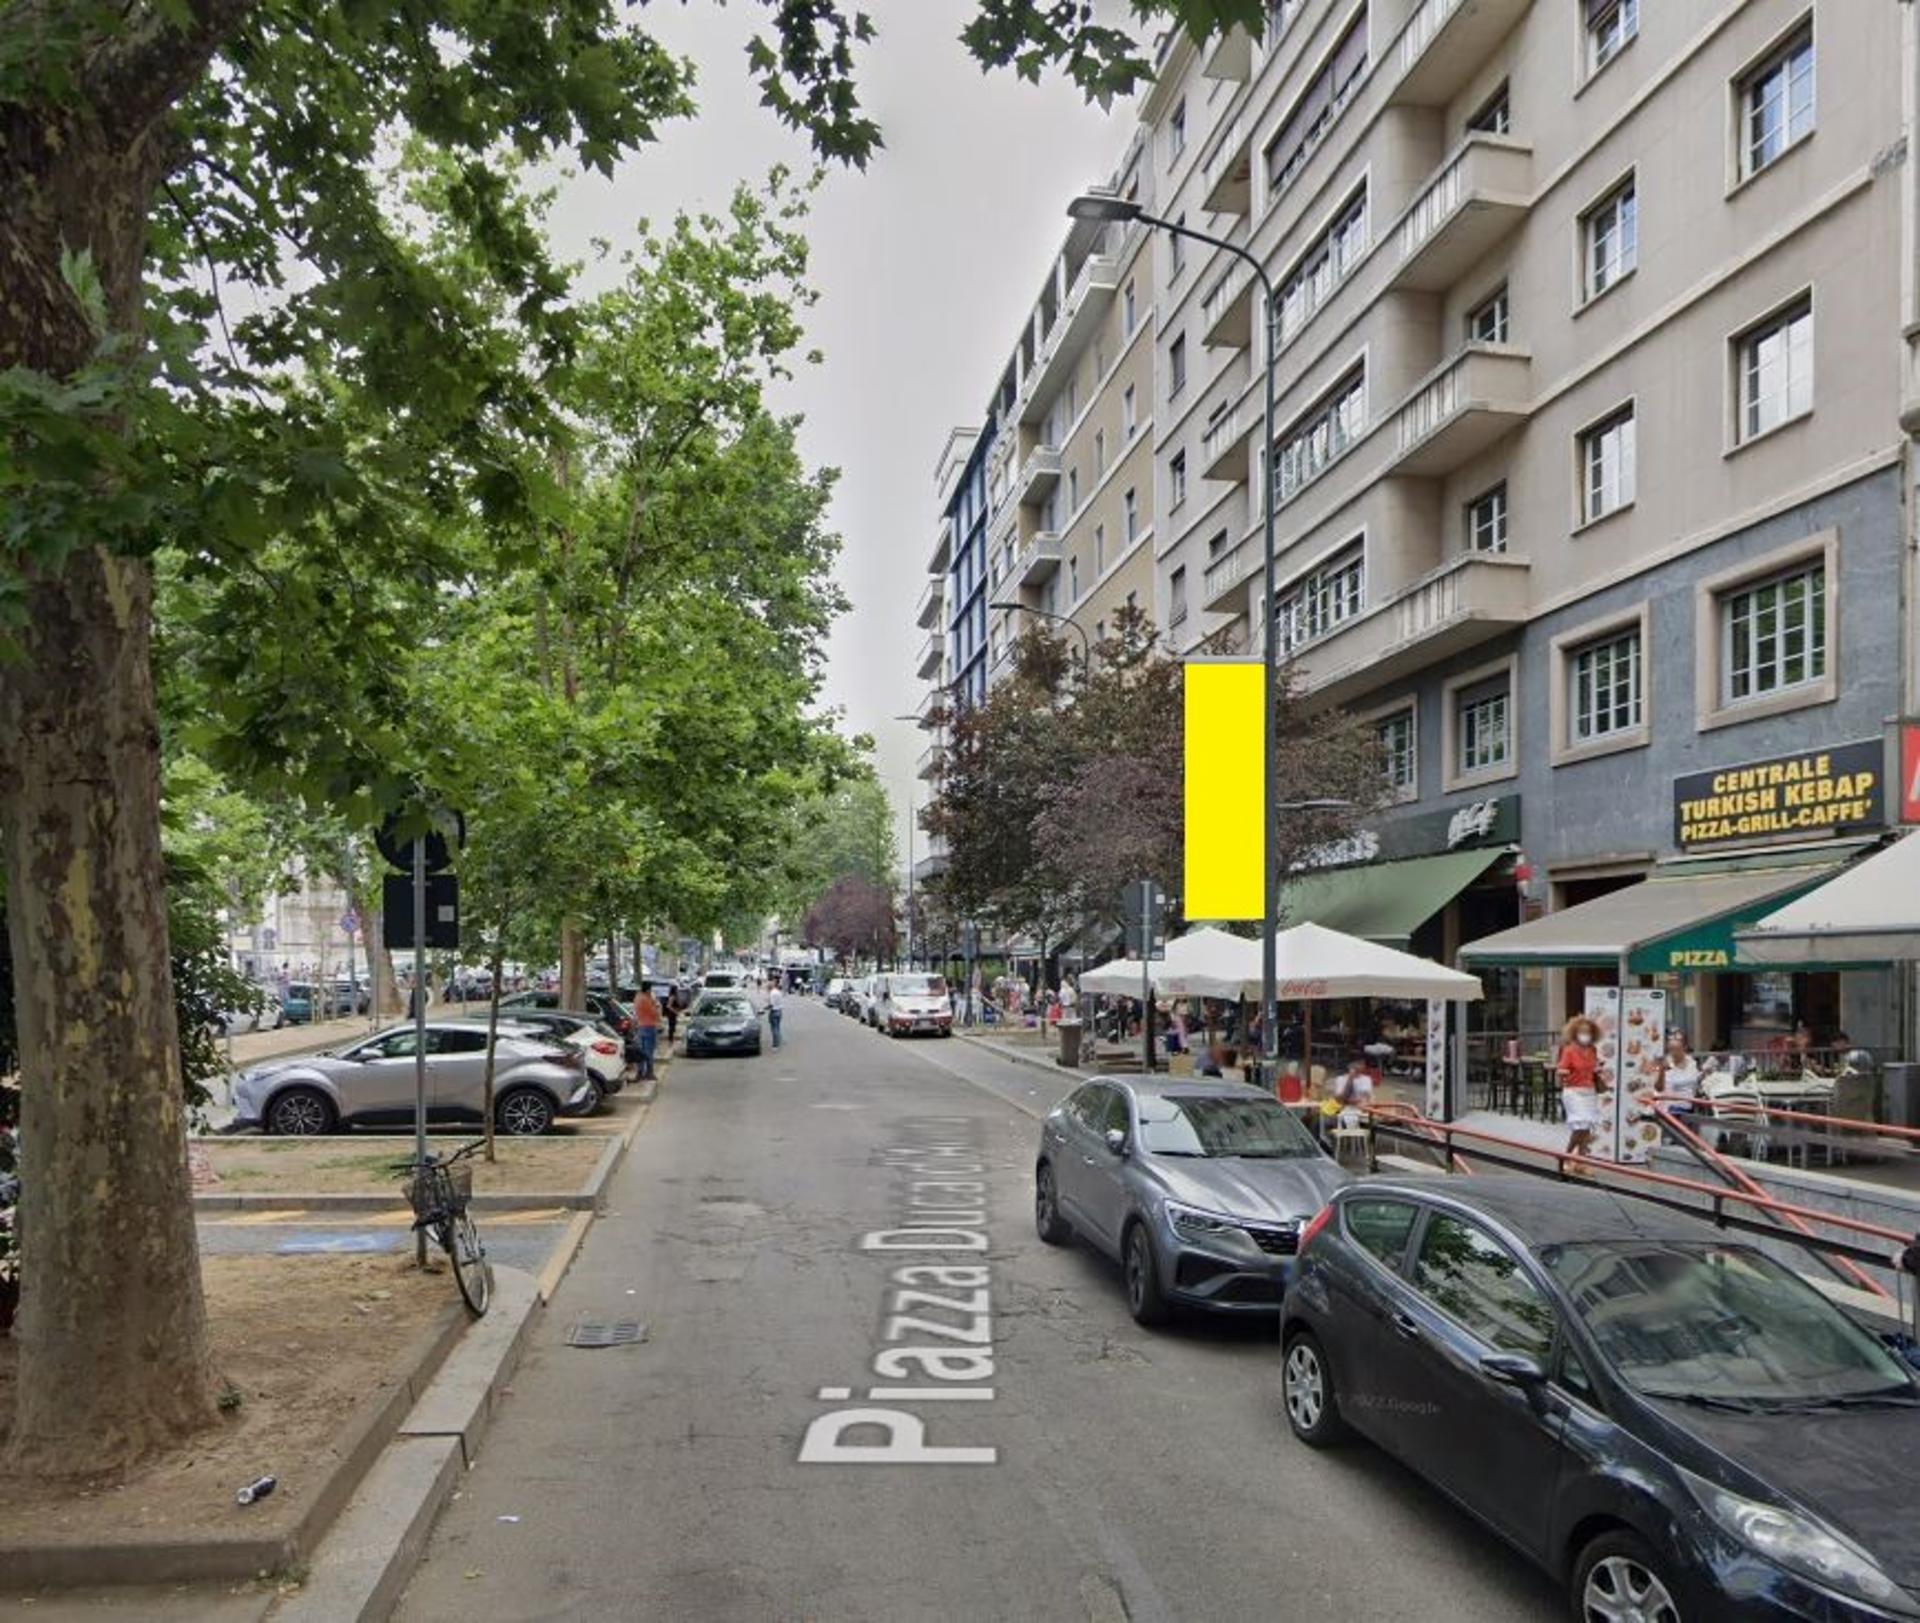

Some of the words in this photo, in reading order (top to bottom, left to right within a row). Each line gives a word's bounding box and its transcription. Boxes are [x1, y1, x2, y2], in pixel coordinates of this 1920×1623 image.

[1713, 754, 1830, 794] CENTRALE
[1680, 789, 1776, 822] TURKISH
[1784, 772, 1874, 807] KEBAP
[1669, 949, 1729, 967] PIZZA
